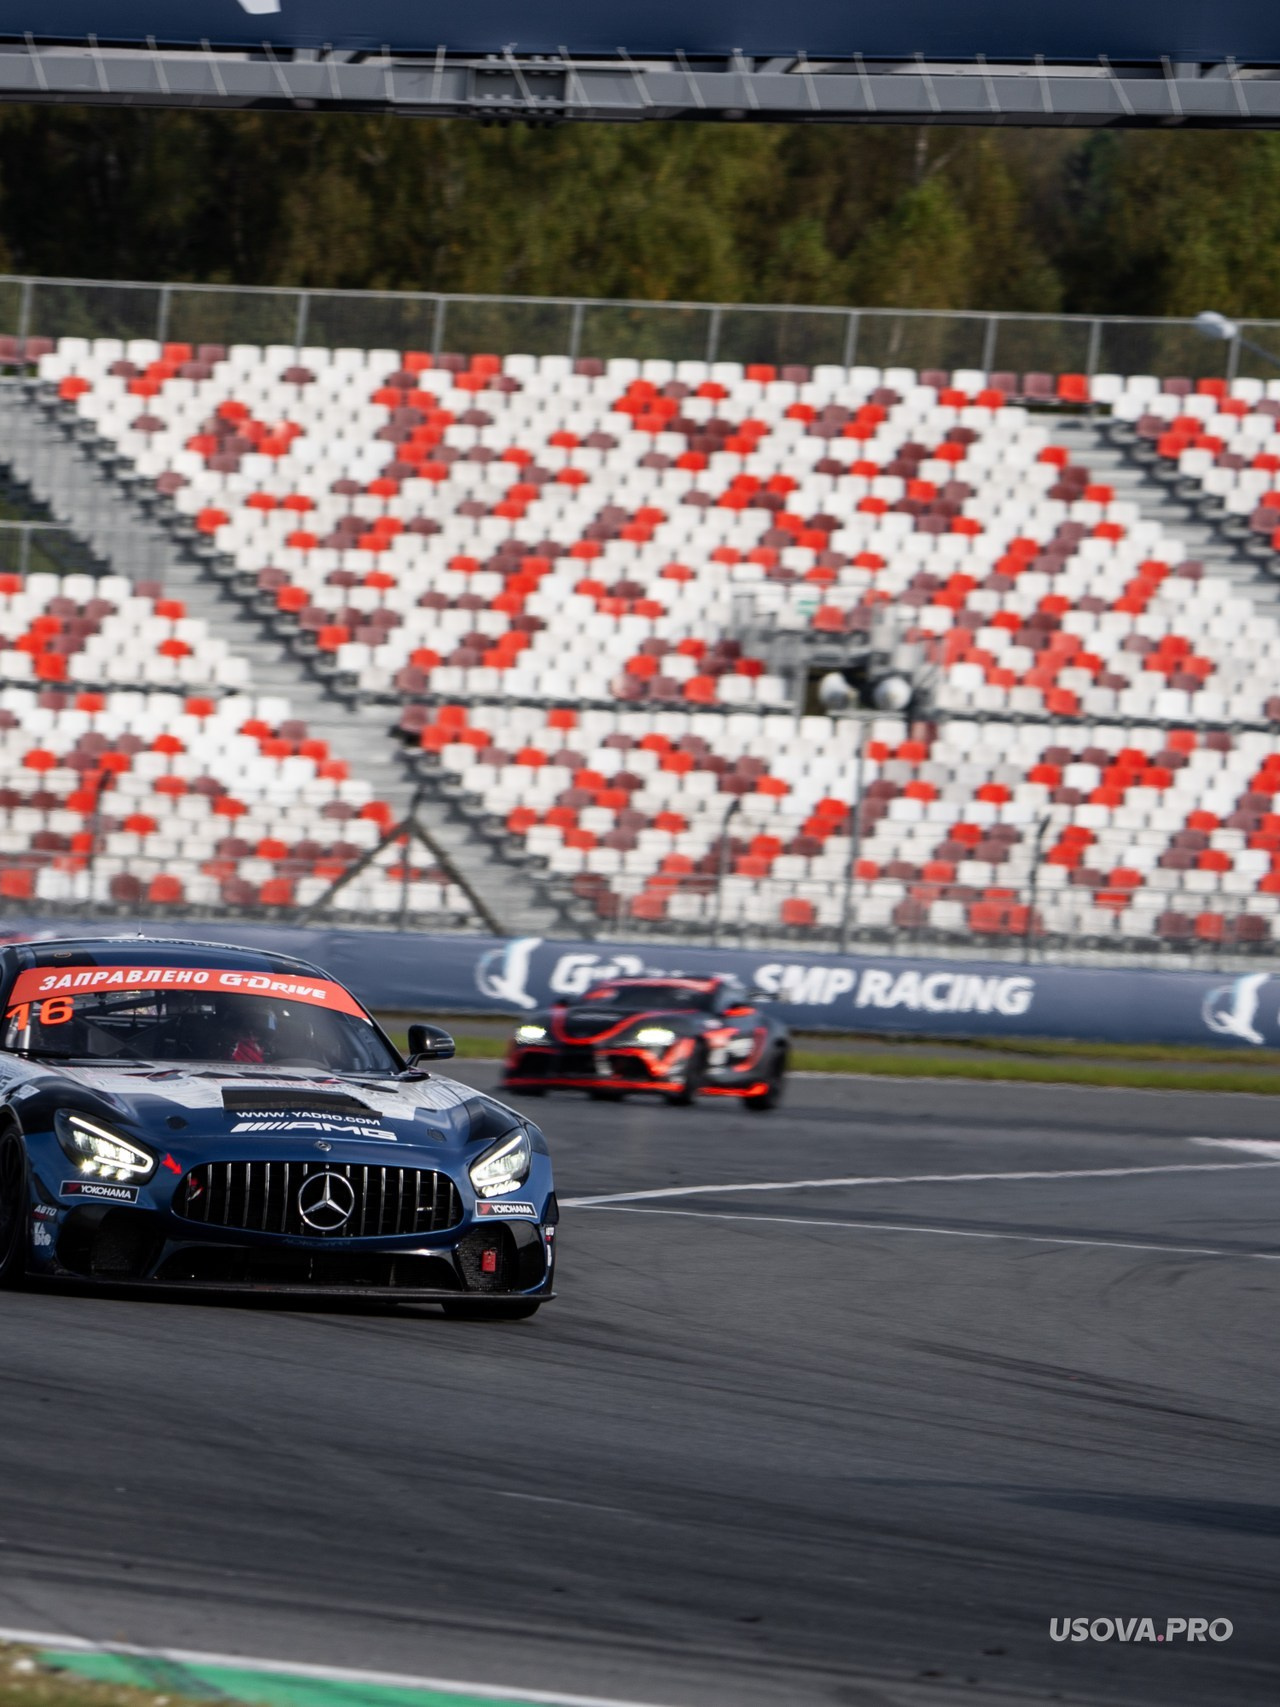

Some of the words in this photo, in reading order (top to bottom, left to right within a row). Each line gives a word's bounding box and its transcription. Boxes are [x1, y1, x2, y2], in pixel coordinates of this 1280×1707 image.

[39, 970, 209, 991] ЗАПРАВЛЕНО
[753, 963, 855, 1006] SMP
[855, 969, 1036, 1016] RACING
[5, 996, 75, 1031] 16
[283, 1122, 398, 1141] AMG
[81, 1184, 132, 1199] YOKOHAMA
[491, 1204, 533, 1214] YOKOHAMA
